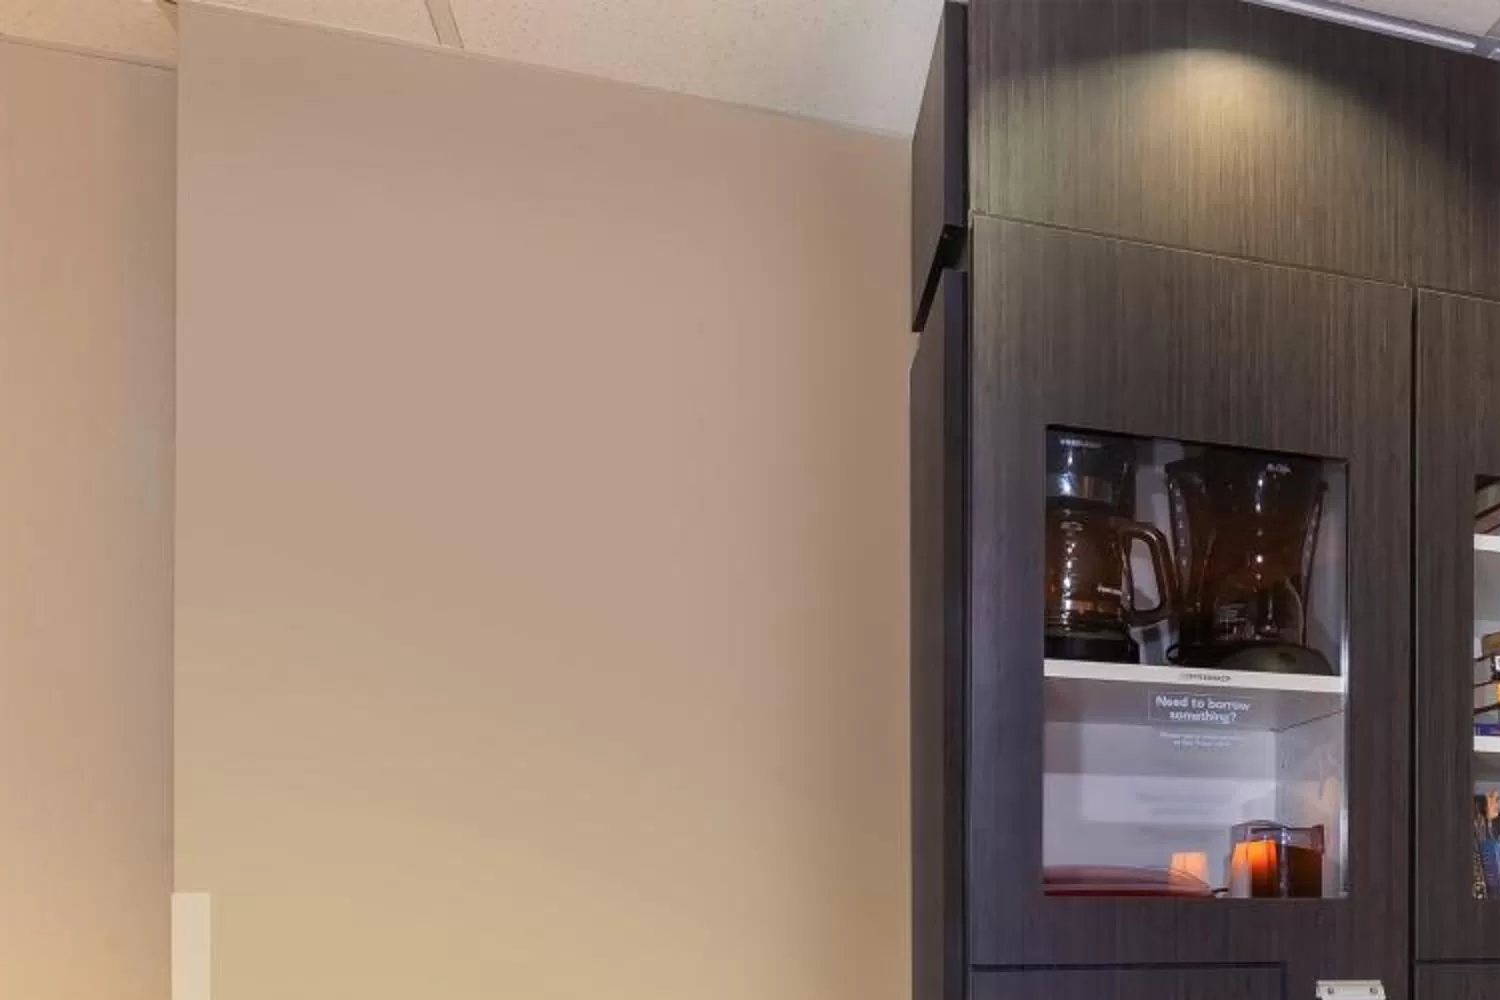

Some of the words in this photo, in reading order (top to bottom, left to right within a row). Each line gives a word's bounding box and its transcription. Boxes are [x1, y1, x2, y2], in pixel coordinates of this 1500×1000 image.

[1156, 695, 1189, 708] Need
[1191, 697, 1205, 709] to
[1207, 697, 1251, 711] borrow
[1169, 709, 1237, 725] something?
